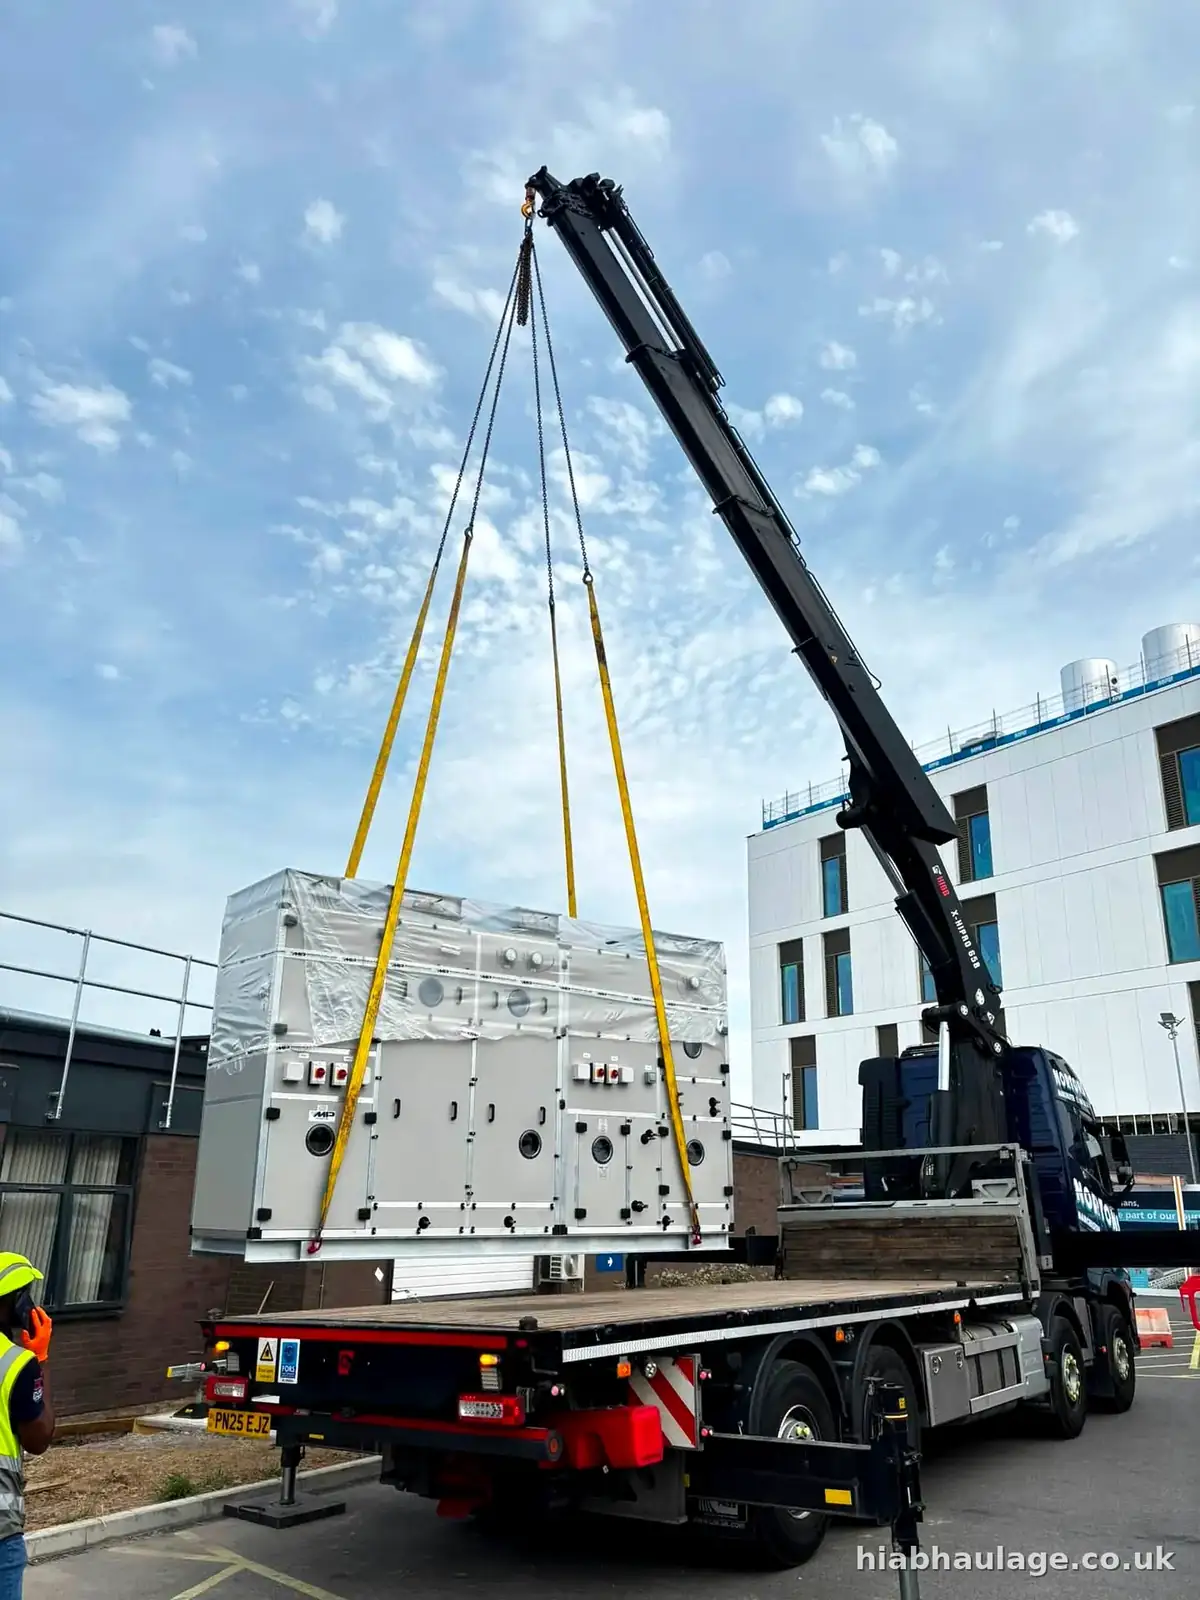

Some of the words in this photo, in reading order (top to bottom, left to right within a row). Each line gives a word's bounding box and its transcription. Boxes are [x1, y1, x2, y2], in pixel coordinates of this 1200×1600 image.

[951, 909, 972, 948] X-HIPRO
[1125, 1211, 1145, 1221] part
[1147, 1210, 1157, 1220] of
[214, 1412, 244, 1431] PN25
[246, 1414, 269, 1434] EJZ
